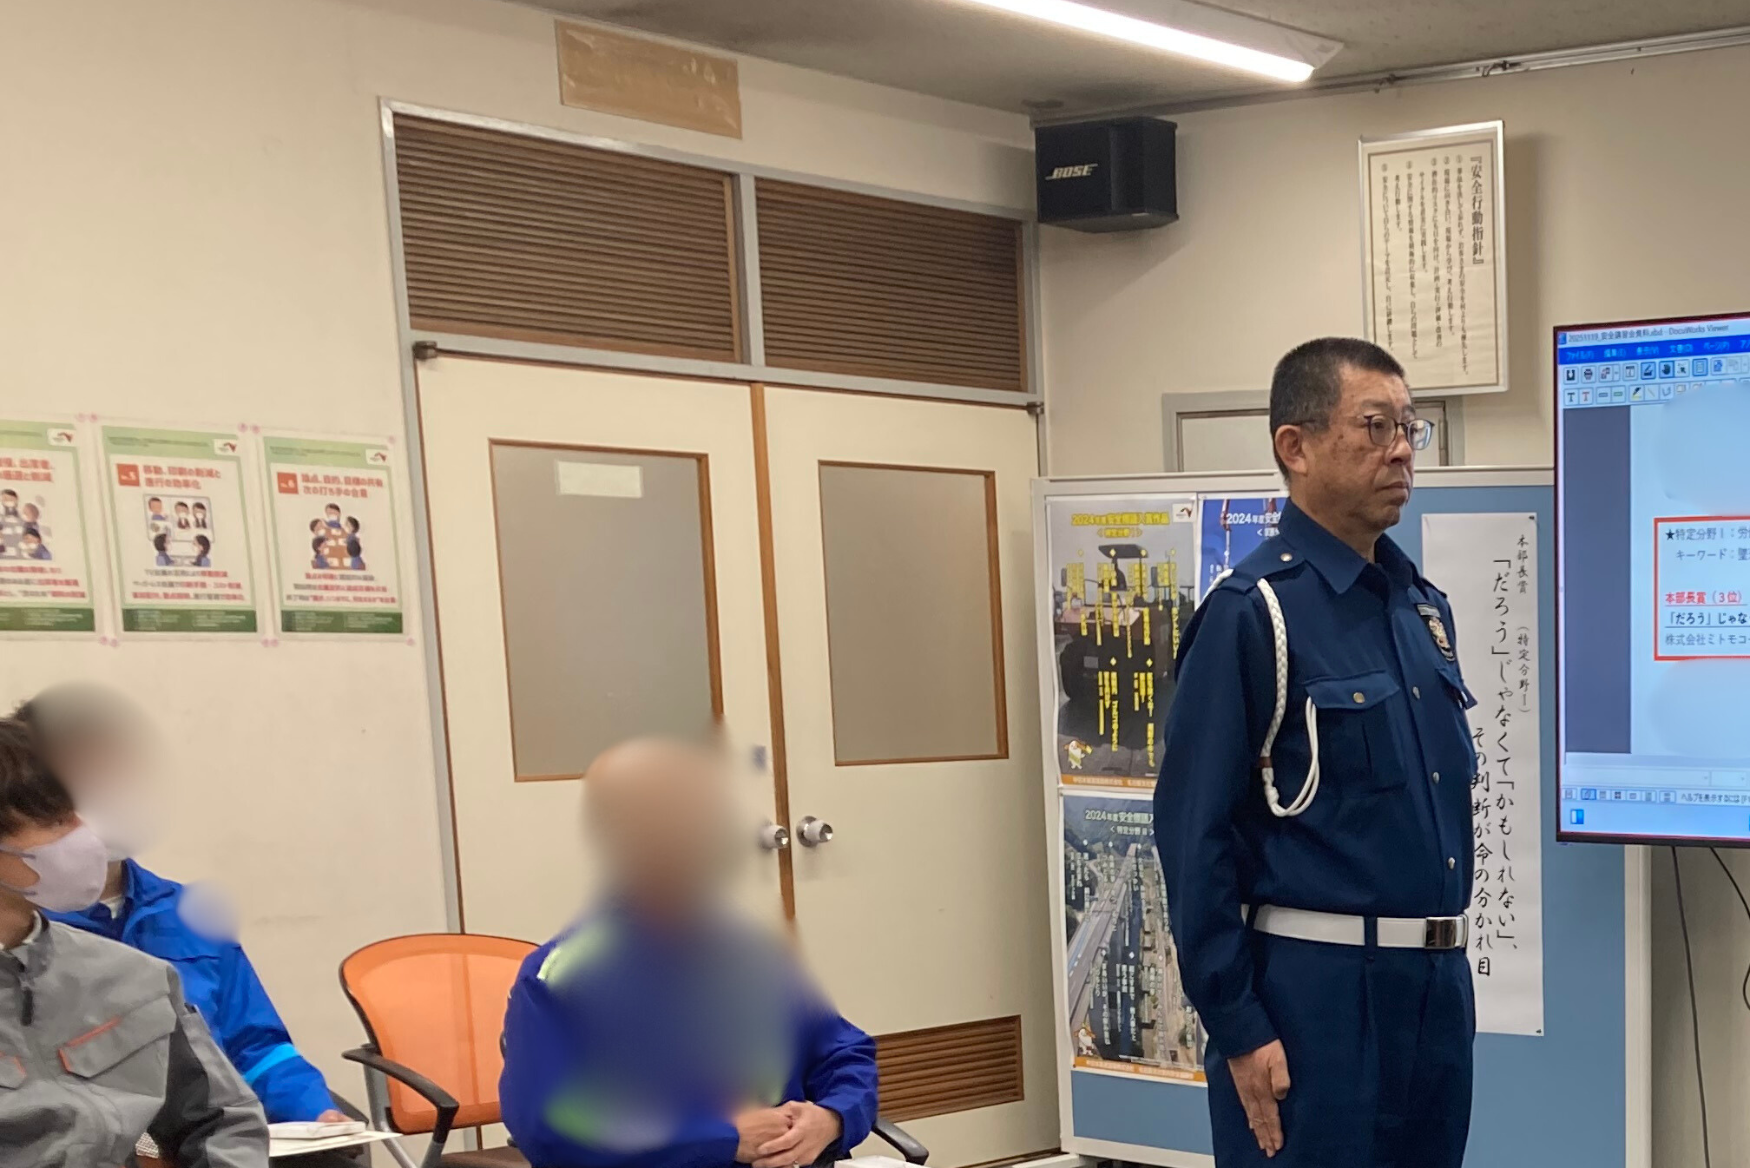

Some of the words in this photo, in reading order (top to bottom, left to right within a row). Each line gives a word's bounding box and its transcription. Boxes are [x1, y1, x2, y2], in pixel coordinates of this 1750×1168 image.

[1045, 163, 1098, 180] BOSE
[1517, 534, 1529, 594] 本部長賞
